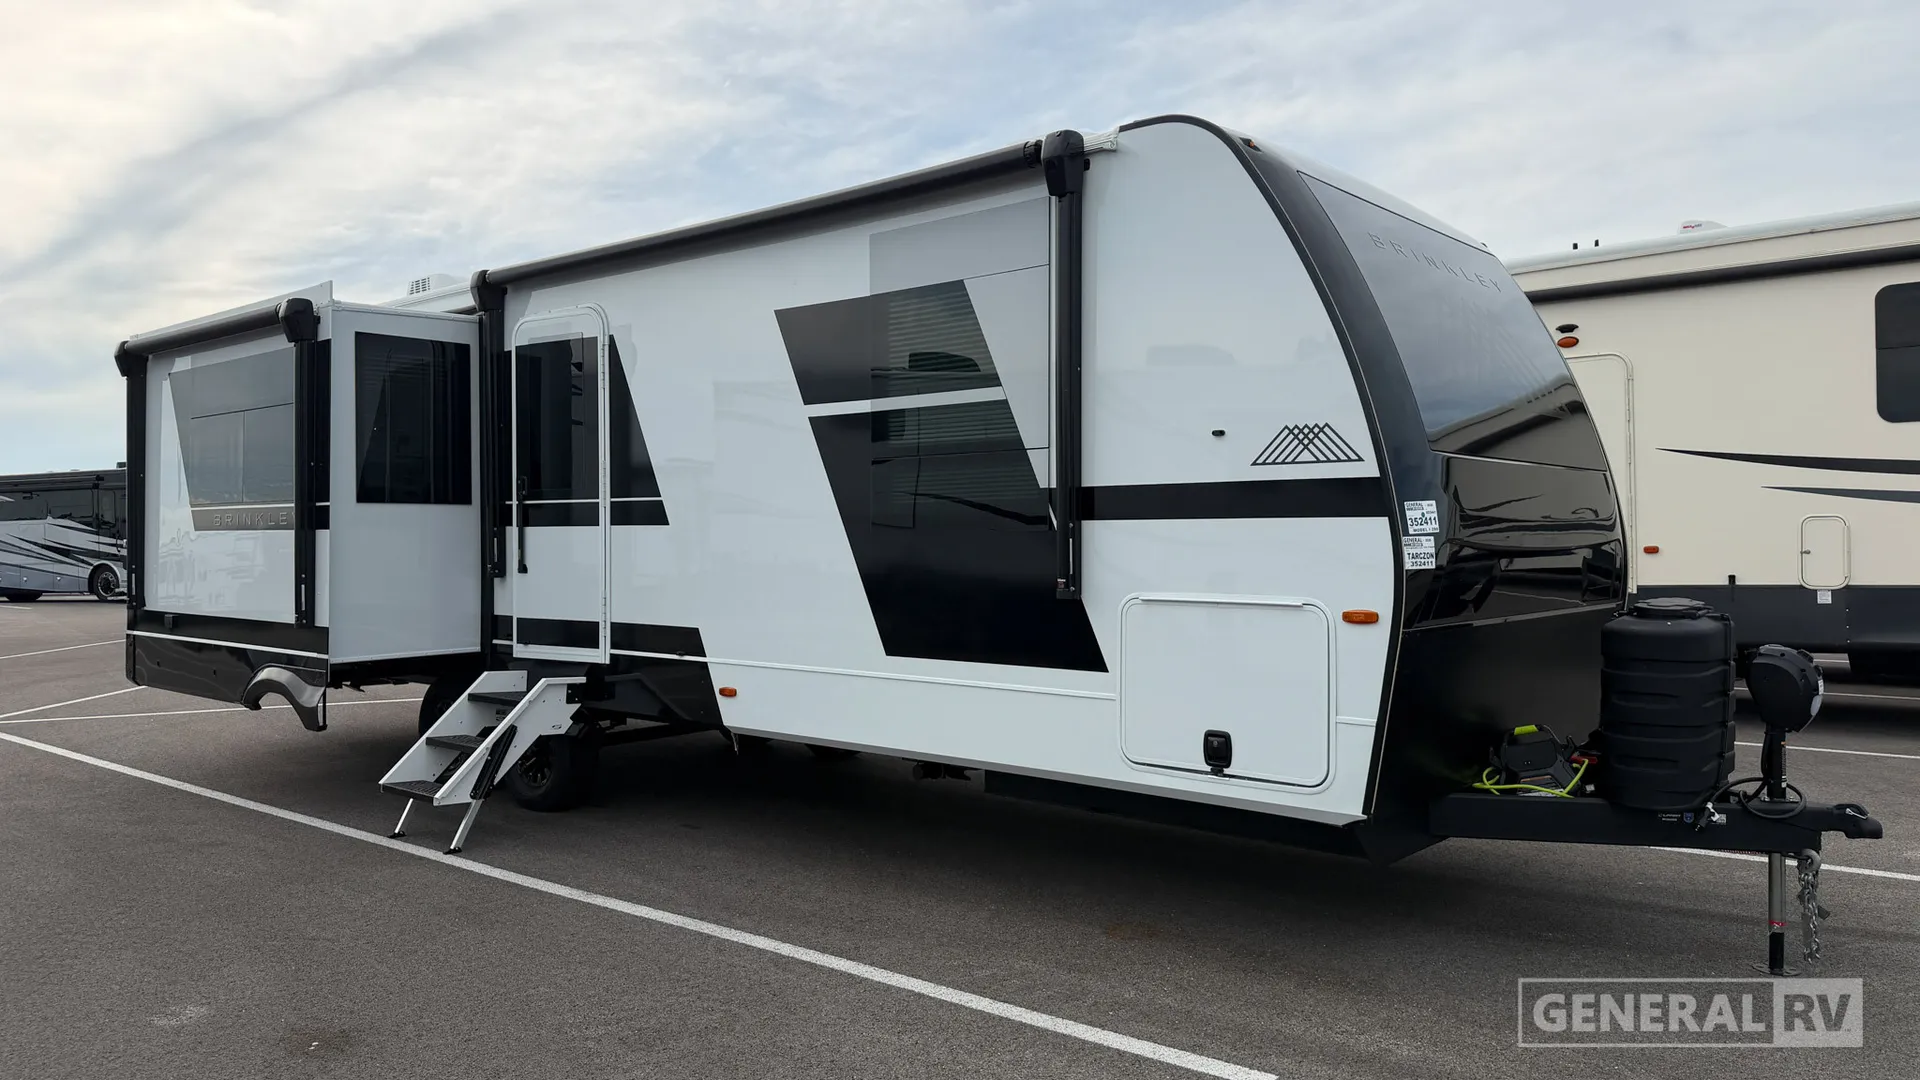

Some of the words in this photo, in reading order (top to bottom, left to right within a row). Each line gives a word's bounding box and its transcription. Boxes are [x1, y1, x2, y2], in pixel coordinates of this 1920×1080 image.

[1367, 231, 1502, 293] BRINKLEY
[213, 511, 296, 526] BRINKLE
[1408, 516, 1437, 527] 352411
